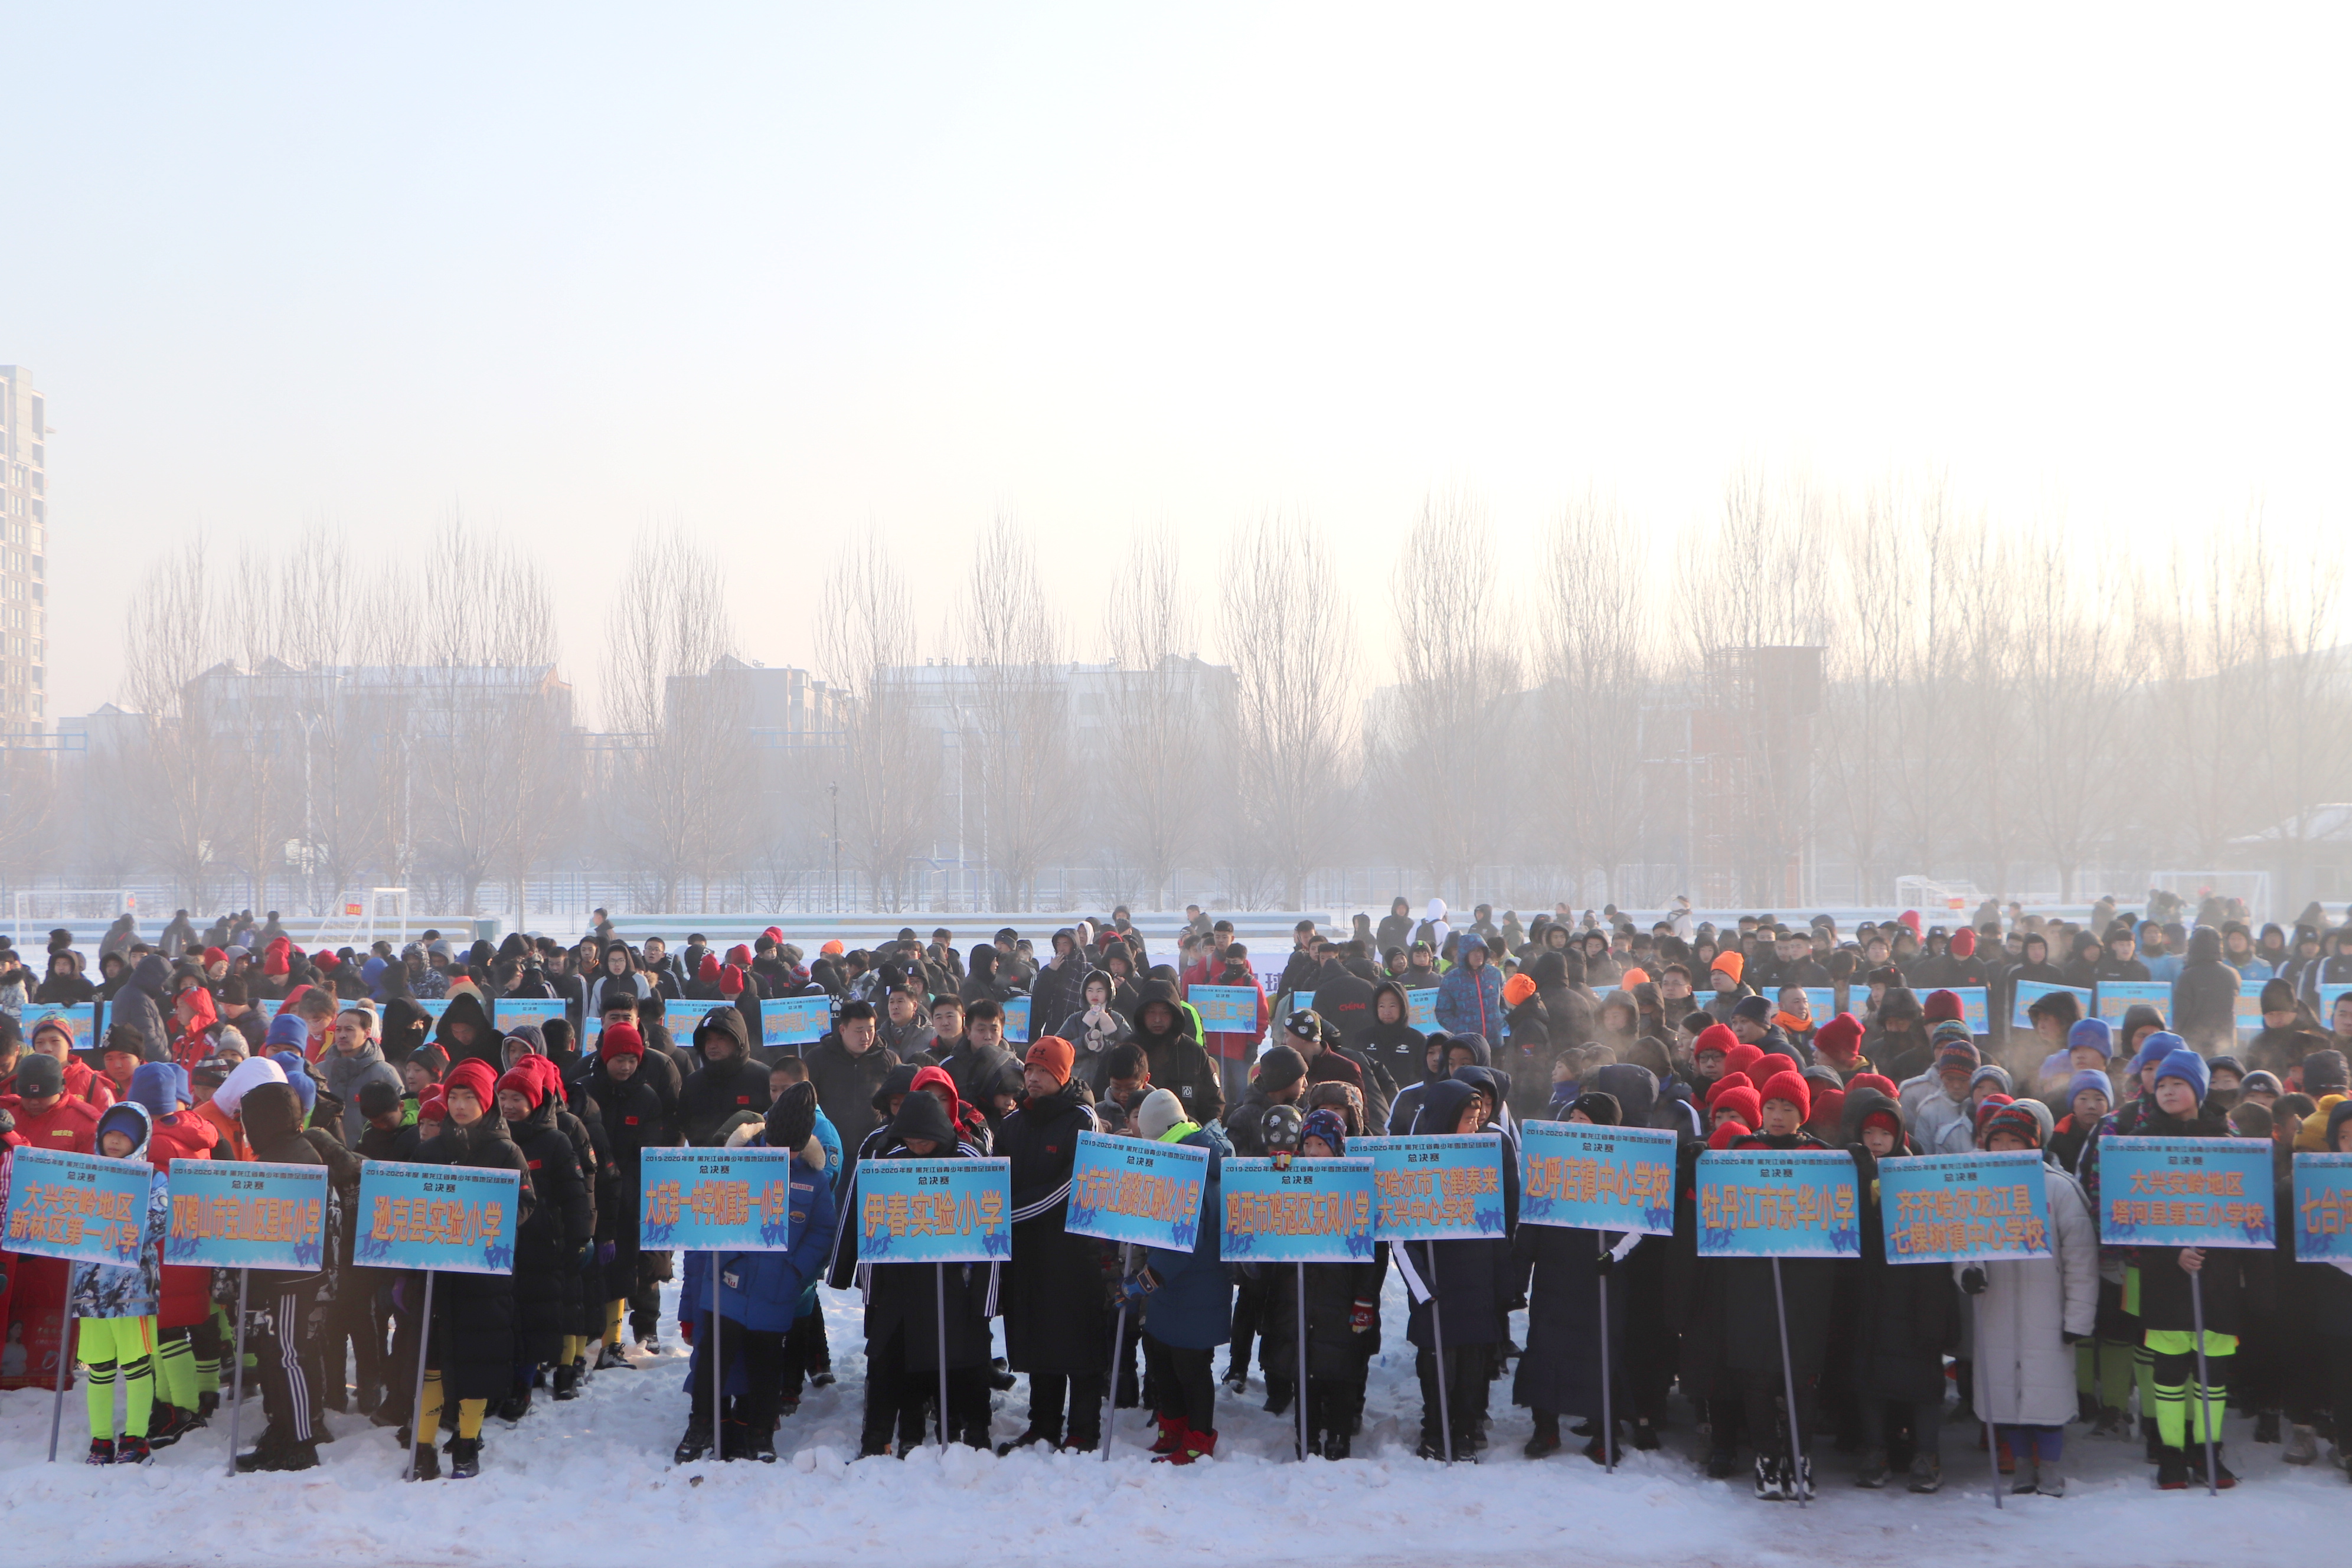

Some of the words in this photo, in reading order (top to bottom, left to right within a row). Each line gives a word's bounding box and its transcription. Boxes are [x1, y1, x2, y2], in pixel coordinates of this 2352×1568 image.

[1081, 1139, 1124, 1151] 2019-2020年度
[1408, 1153, 1439, 1162] 总决赛
[1583, 1142, 1614, 1152] 总决赛
[700, 1165, 730, 1174] 总决赛
[1127, 1155, 1154, 1167] 总决赛
[1760, 1168, 1793, 1177] 总决赛
[67, 1171, 96, 1182] 总决赛
[232, 1180, 264, 1190] 总决赛
[423, 1182, 456, 1193] 总决赛
[918, 1176, 949, 1185] 总决赛
[1282, 1175, 1312, 1184] 总决赛
[1525, 1153, 1671, 1209] 达呼店镇中心学校
[1945, 1172, 1977, 1182] 总决赛
[2129, 1169, 2245, 1195] 大兴安岭地区
[22, 1180, 136, 1222] 大兴安岭地区
[645, 1180, 785, 1225] 大庆第一中学附属第一小学
[863, 1190, 1002, 1238] 伊春实验小学
[1226, 1190, 1370, 1236] 鸡西市鸡冠区东风小学
[1378, 1197, 1475, 1227] 大兴中心学校
[1702, 1182, 1855, 1231] 牡丹江市东华小学
[1896, 1184, 2032, 1222] 齐齐哈尔龙江县
[2112, 1199, 2265, 1229] 塔河县第五小学校
[9, 1208, 139, 1253] 新林区第一小学
[171, 1193, 322, 1244] 双鸭山市宝山区星旺小学
[371, 1195, 502, 1247] 逊克县实验小学
